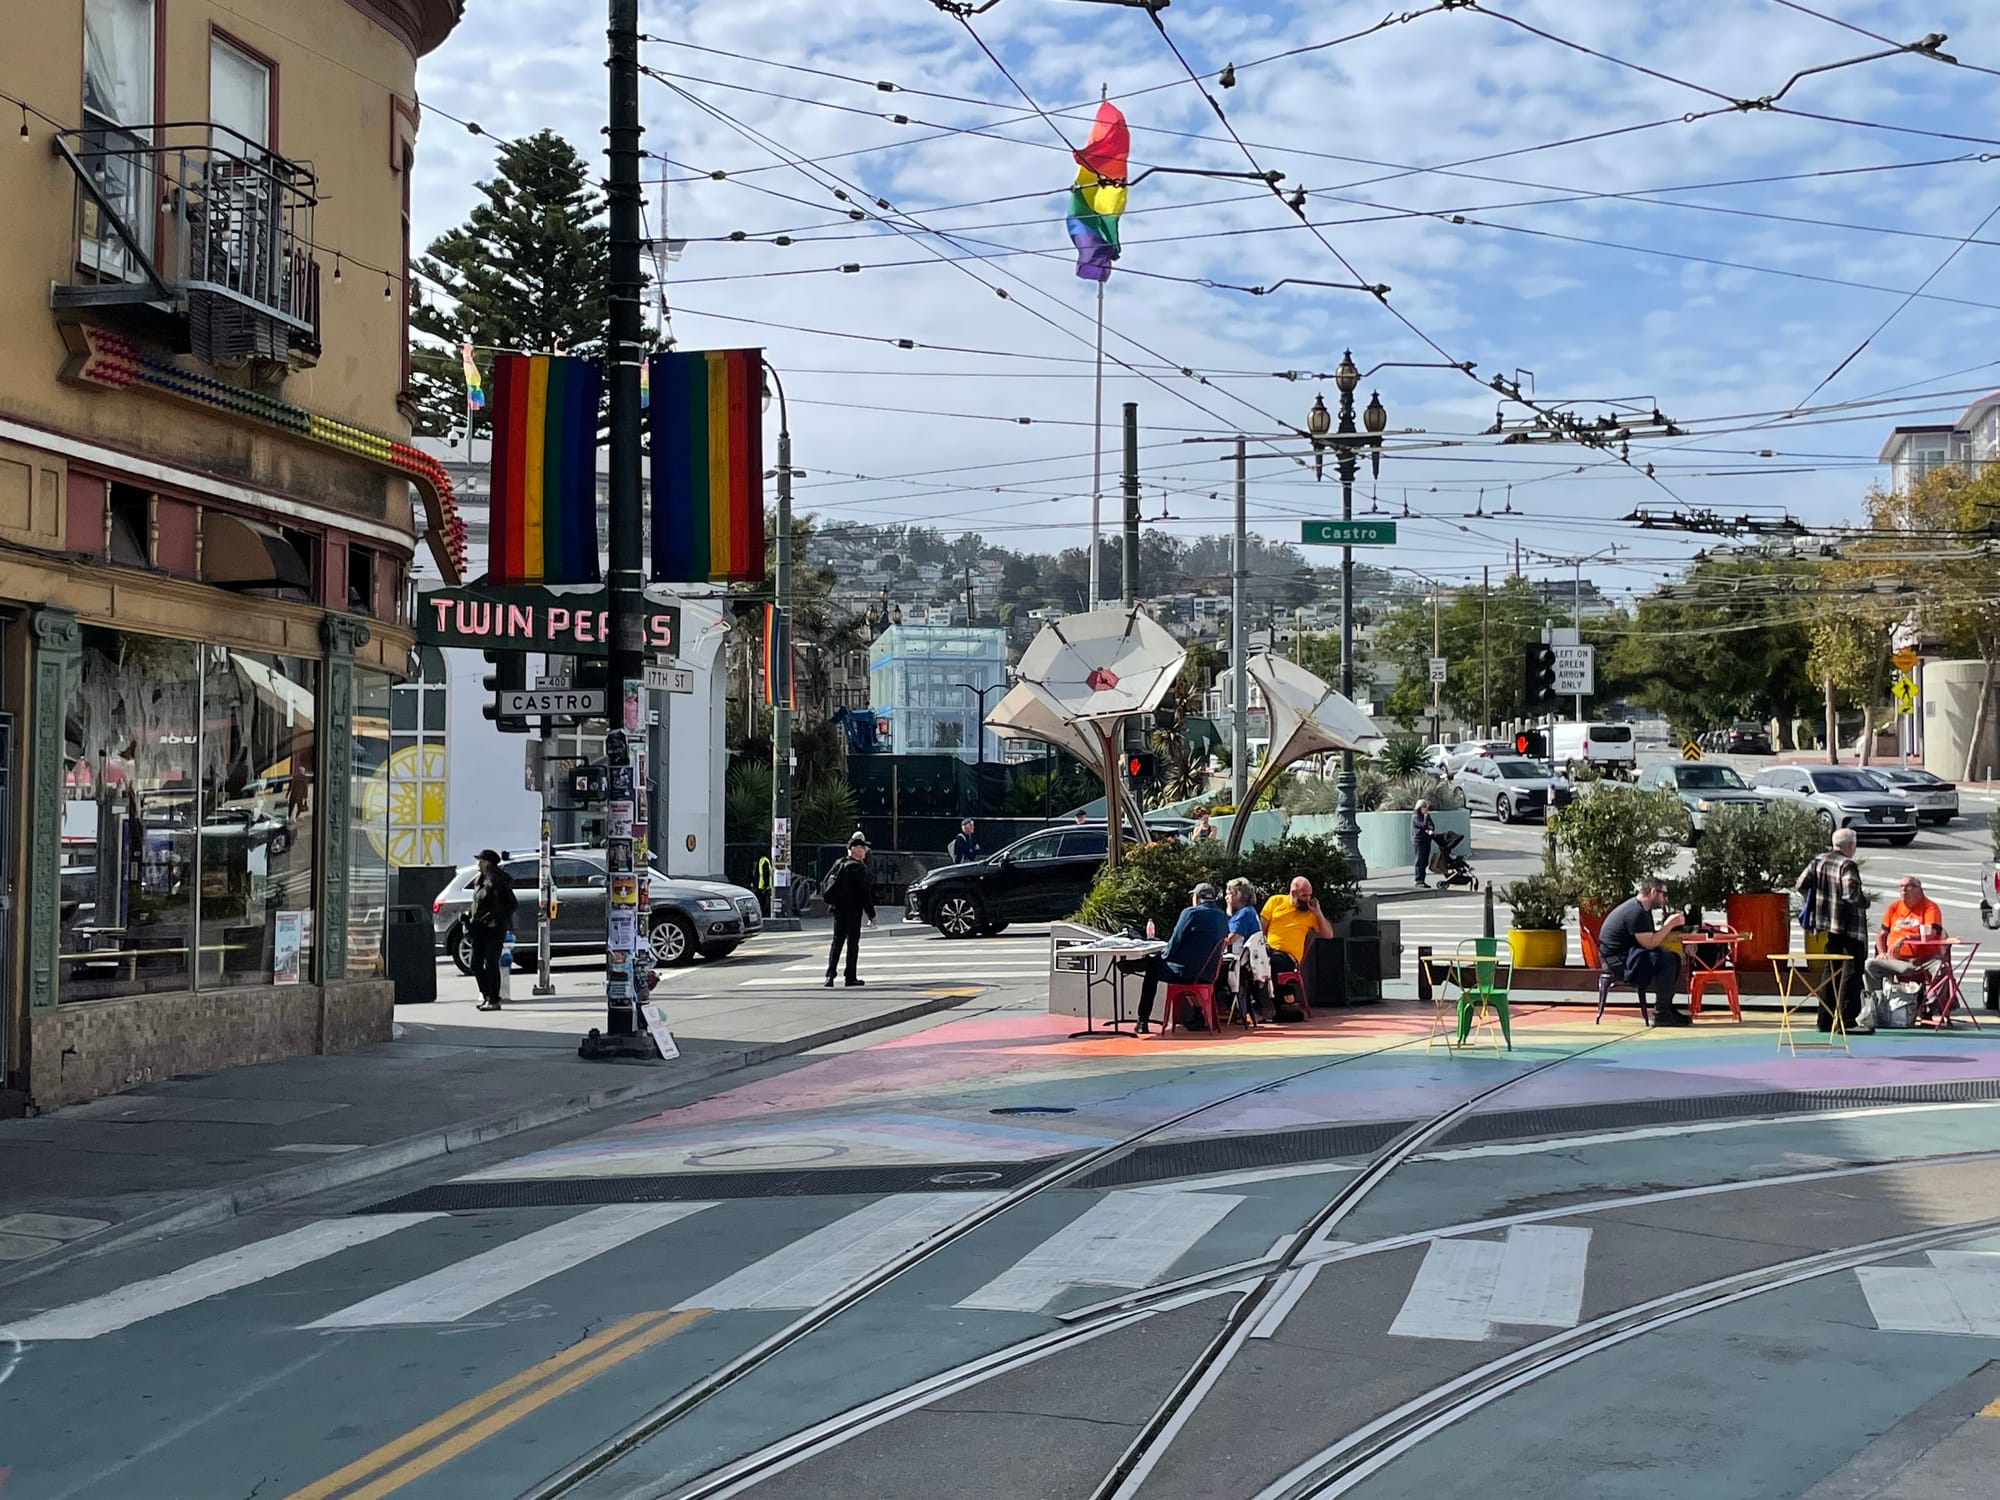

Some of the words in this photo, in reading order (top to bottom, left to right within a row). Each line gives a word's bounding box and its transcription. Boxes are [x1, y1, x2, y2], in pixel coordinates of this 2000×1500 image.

[1321, 526, 1377, 540] Castro
[430, 598, 533, 639] TWIN
[548, 607, 671, 647] PEAS
[1555, 650, 1573, 658] LEFT
[1577, 650, 1588, 658] ON
[1559, 660, 1585, 669] GREEN
[1431, 671, 1445, 680] 25
[1559, 670, 1586, 679] ARROW
[549, 677, 566, 687] 400
[648, 671, 668, 687] 17TH
[674, 673, 685, 689] ST
[1561, 681, 1582, 689] ONLY
[512, 694, 592, 710] CASTRO
